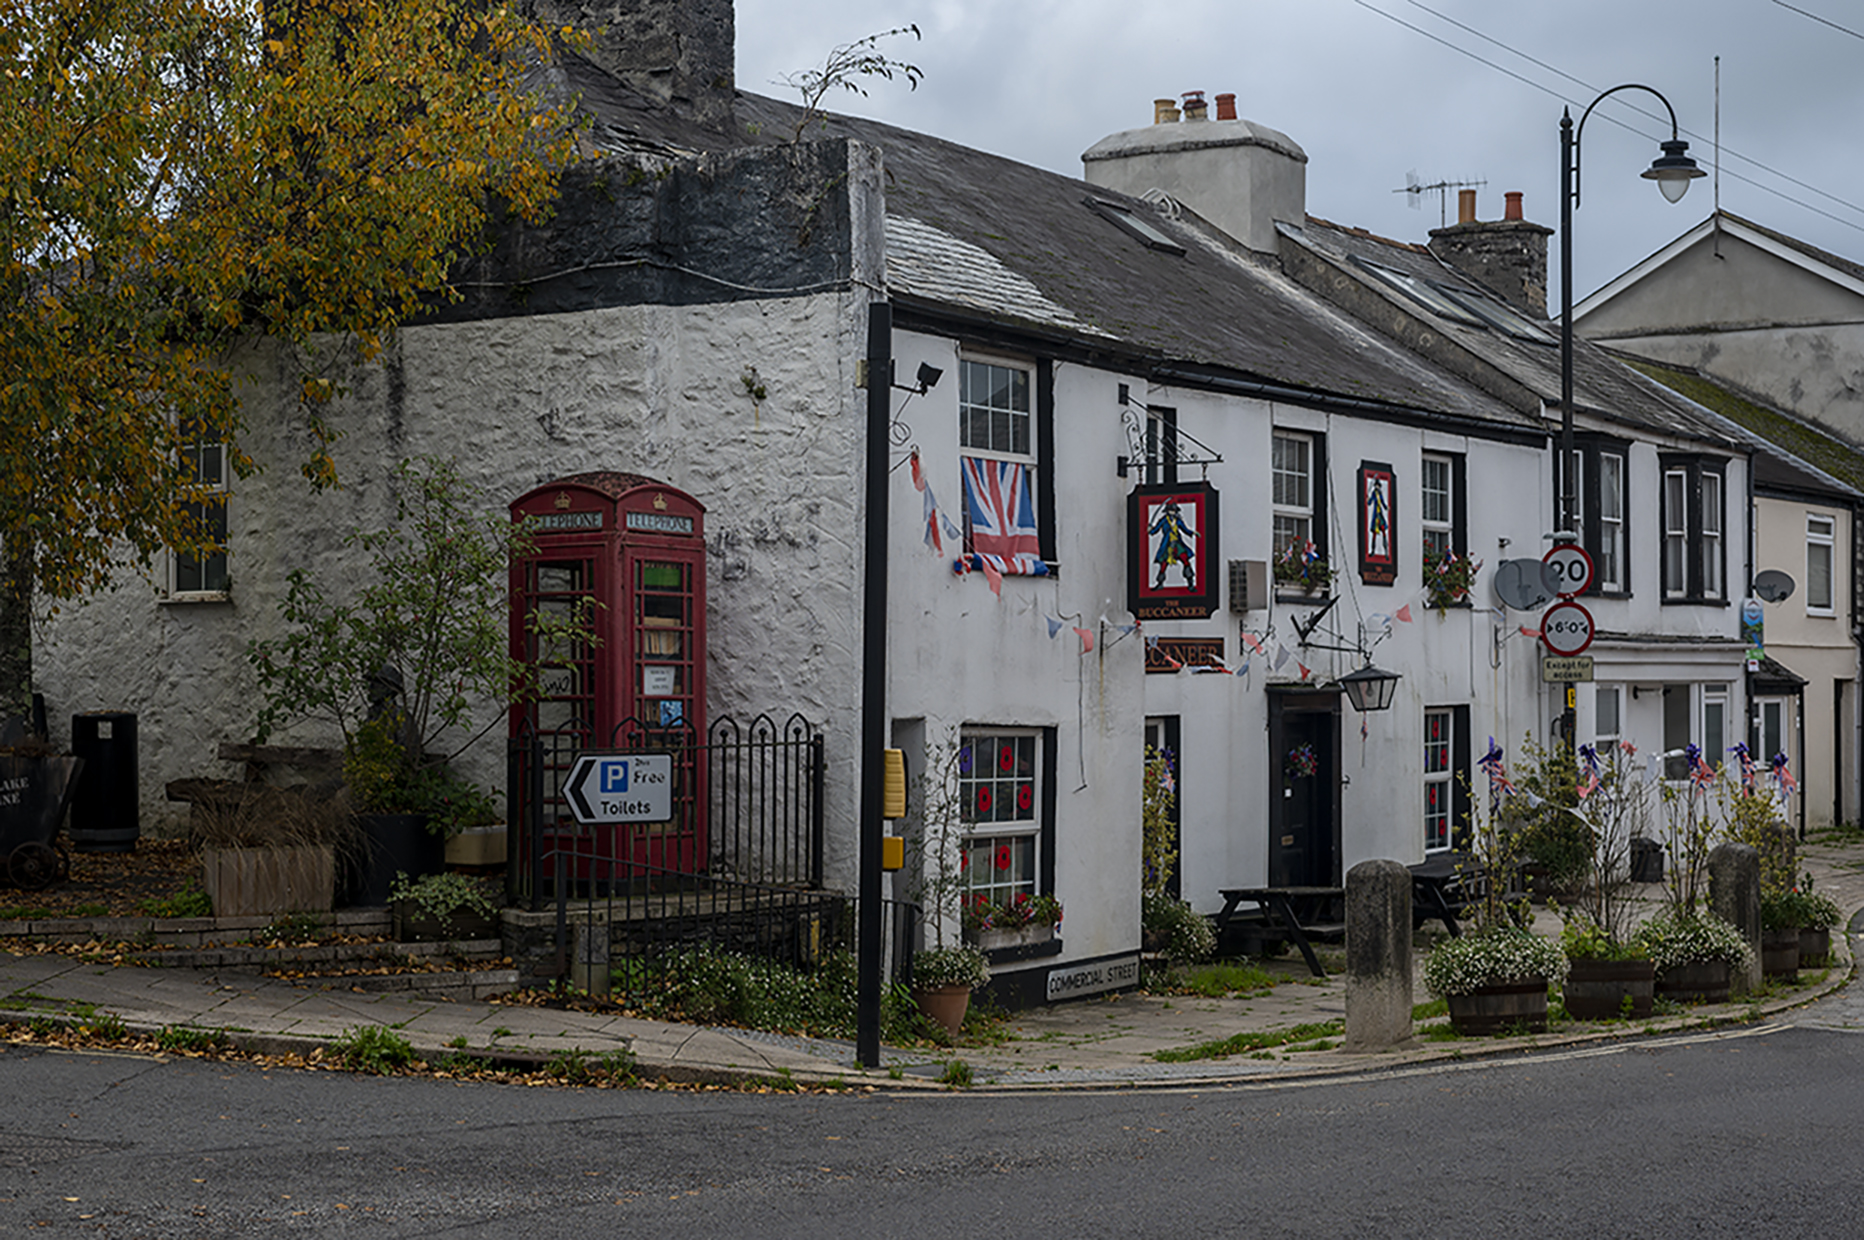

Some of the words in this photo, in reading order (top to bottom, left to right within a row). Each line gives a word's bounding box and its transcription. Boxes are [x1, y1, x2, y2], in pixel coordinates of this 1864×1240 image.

[529, 514, 599, 530] LEPHONE
[628, 512, 691, 532] TELEPHONE
[1549, 560, 1585, 582] 20
[1138, 606, 1207, 618] BUCCANEER
[1546, 660, 1576, 670] Except
[1577, 660, 1590, 669] for
[1553, 671, 1582, 679] access
[607, 765, 624, 789] P
[634, 769, 665, 784] Free
[600, 801, 651, 816] Toilets
[1050, 969, 1103, 993] COMMERCIAL
[1107, 962, 1137, 982] STREET
